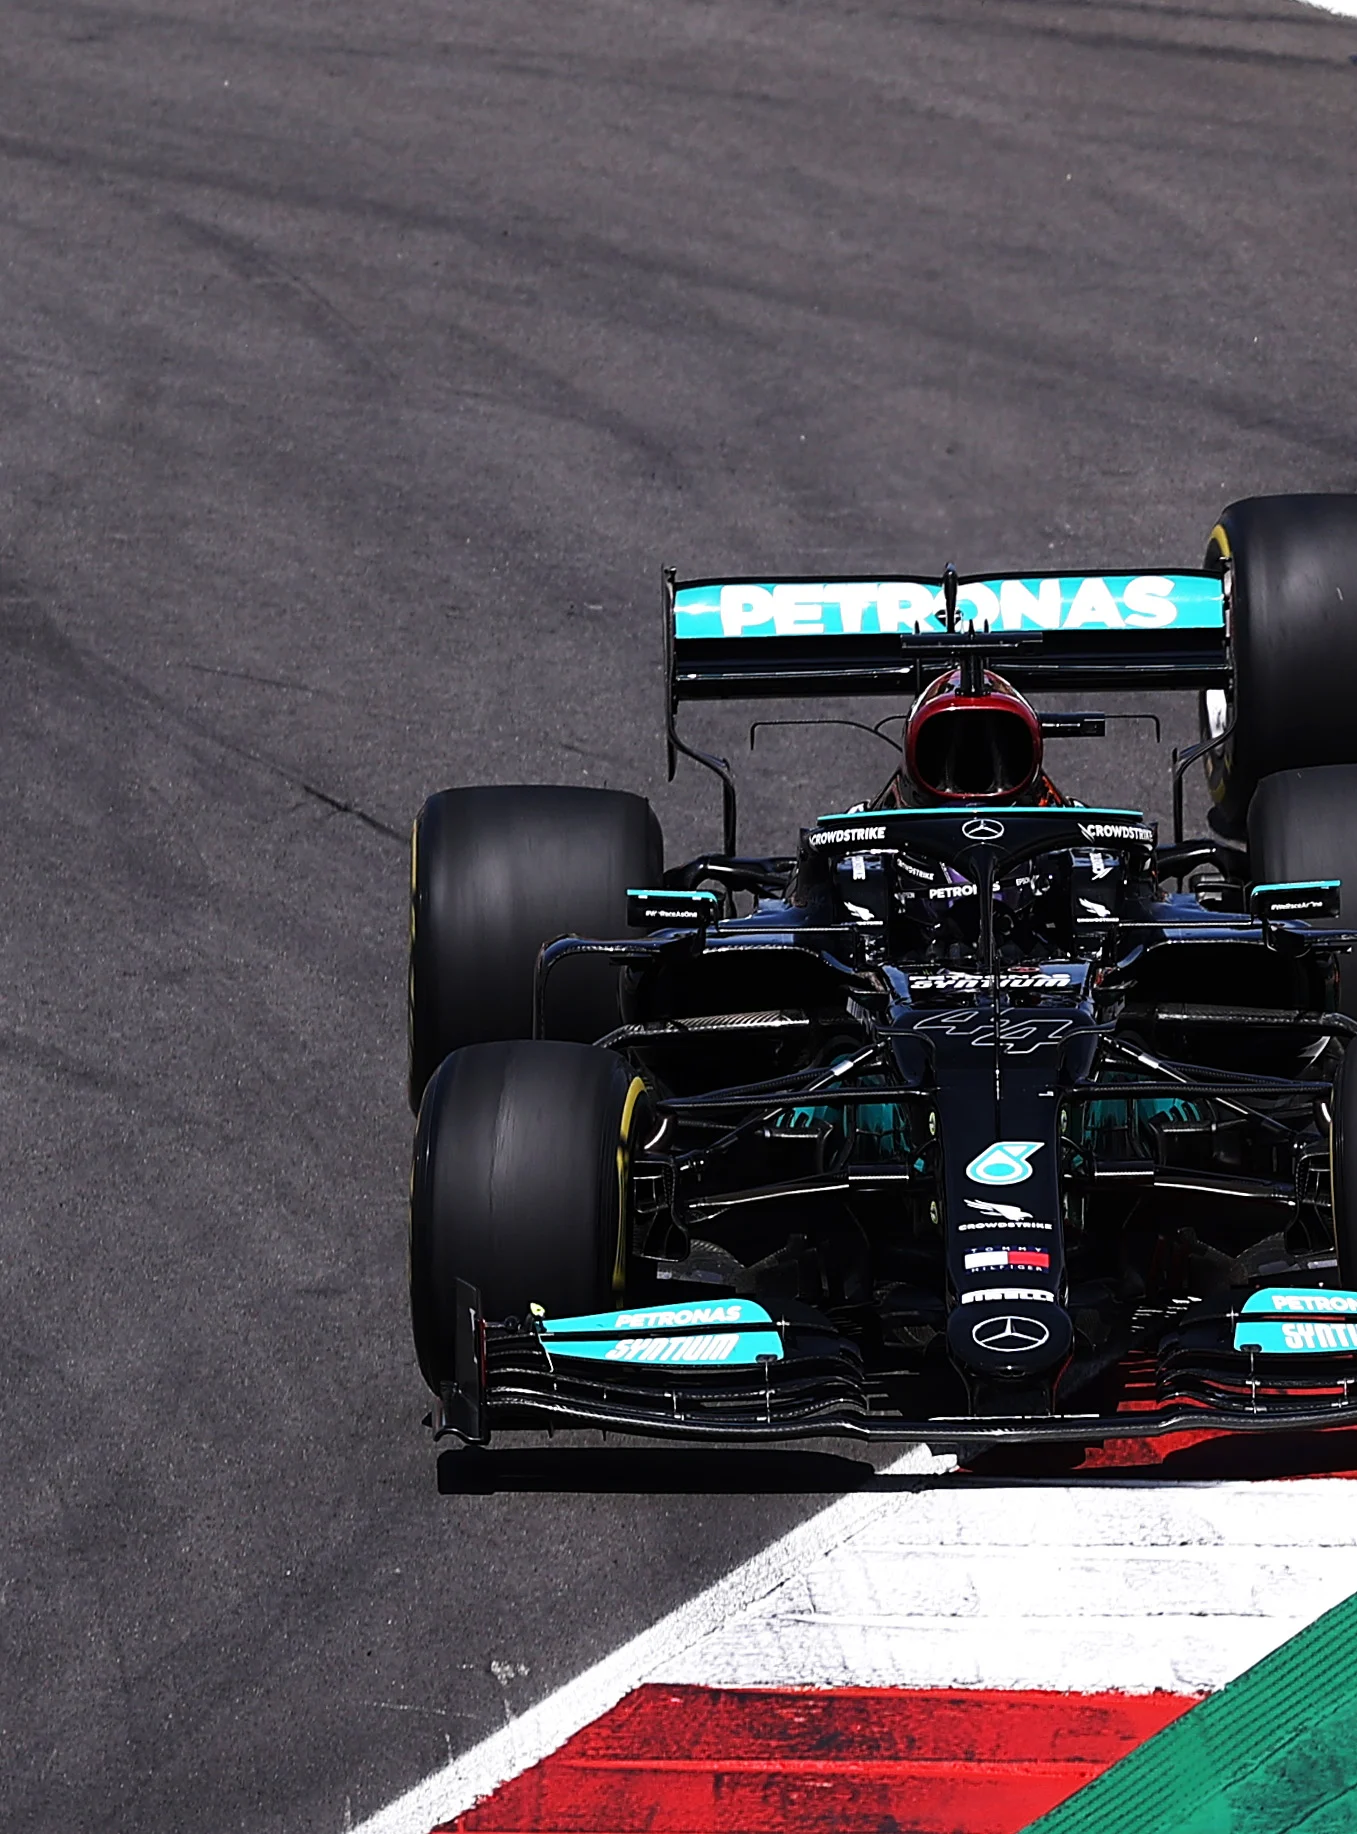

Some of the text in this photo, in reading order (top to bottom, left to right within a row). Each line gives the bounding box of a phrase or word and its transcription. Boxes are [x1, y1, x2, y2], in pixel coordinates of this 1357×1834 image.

[720, 575, 1177, 636] PETRONAS
[810, 826, 886, 846] CROWDSTRIKE
[929, 881, 1000, 899] PETROS
[958, 1222, 1053, 1231] CROWDSTRIKE
[614, 1305, 742, 1328] PETRONAS
[604, 1333, 740, 1361] SYNTIUM
